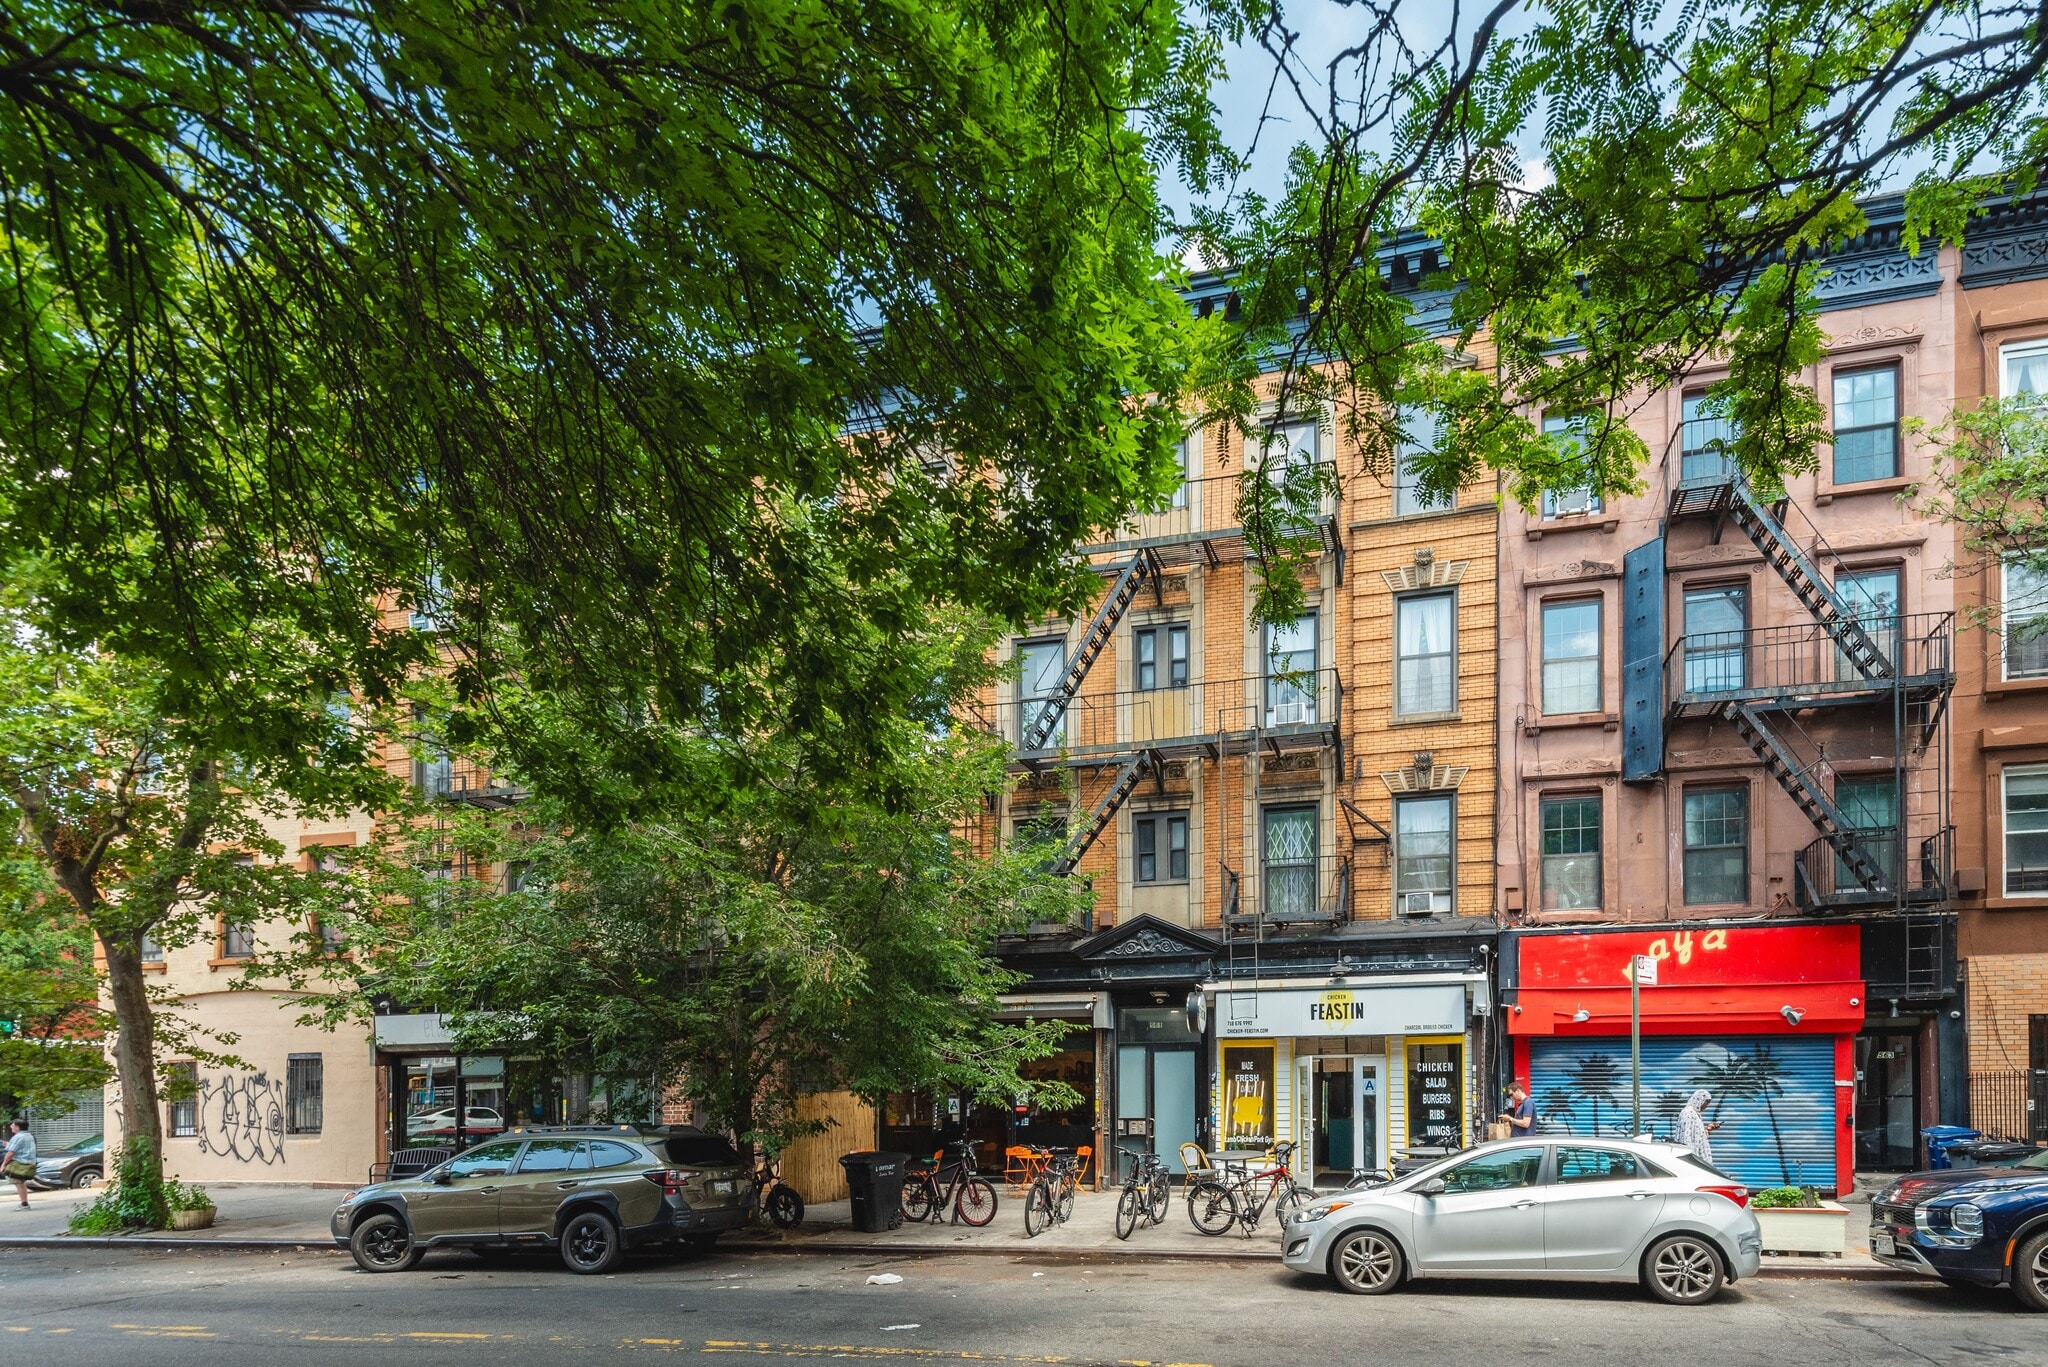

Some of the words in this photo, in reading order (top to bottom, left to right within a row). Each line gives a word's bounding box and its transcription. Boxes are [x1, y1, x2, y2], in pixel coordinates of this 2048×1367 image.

[1310, 1002, 1364, 1020] FEASTIN
[1241, 1061, 1254, 1071] MADE
[1416, 1062, 1454, 1072] CHICKEN
[1235, 1074, 1260, 1082] FRESH
[1425, 1077, 1447, 1088] SALAD
[1240, 1085, 1255, 1093] DAILY
[1365, 1080, 1374, 1091] A
[1422, 1093, 1452, 1104] BURGERS
[950, 1100, 958, 1111] A
[1429, 1109, 1446, 1120] RIBS
[1426, 1125, 1451, 1136] WINGS
